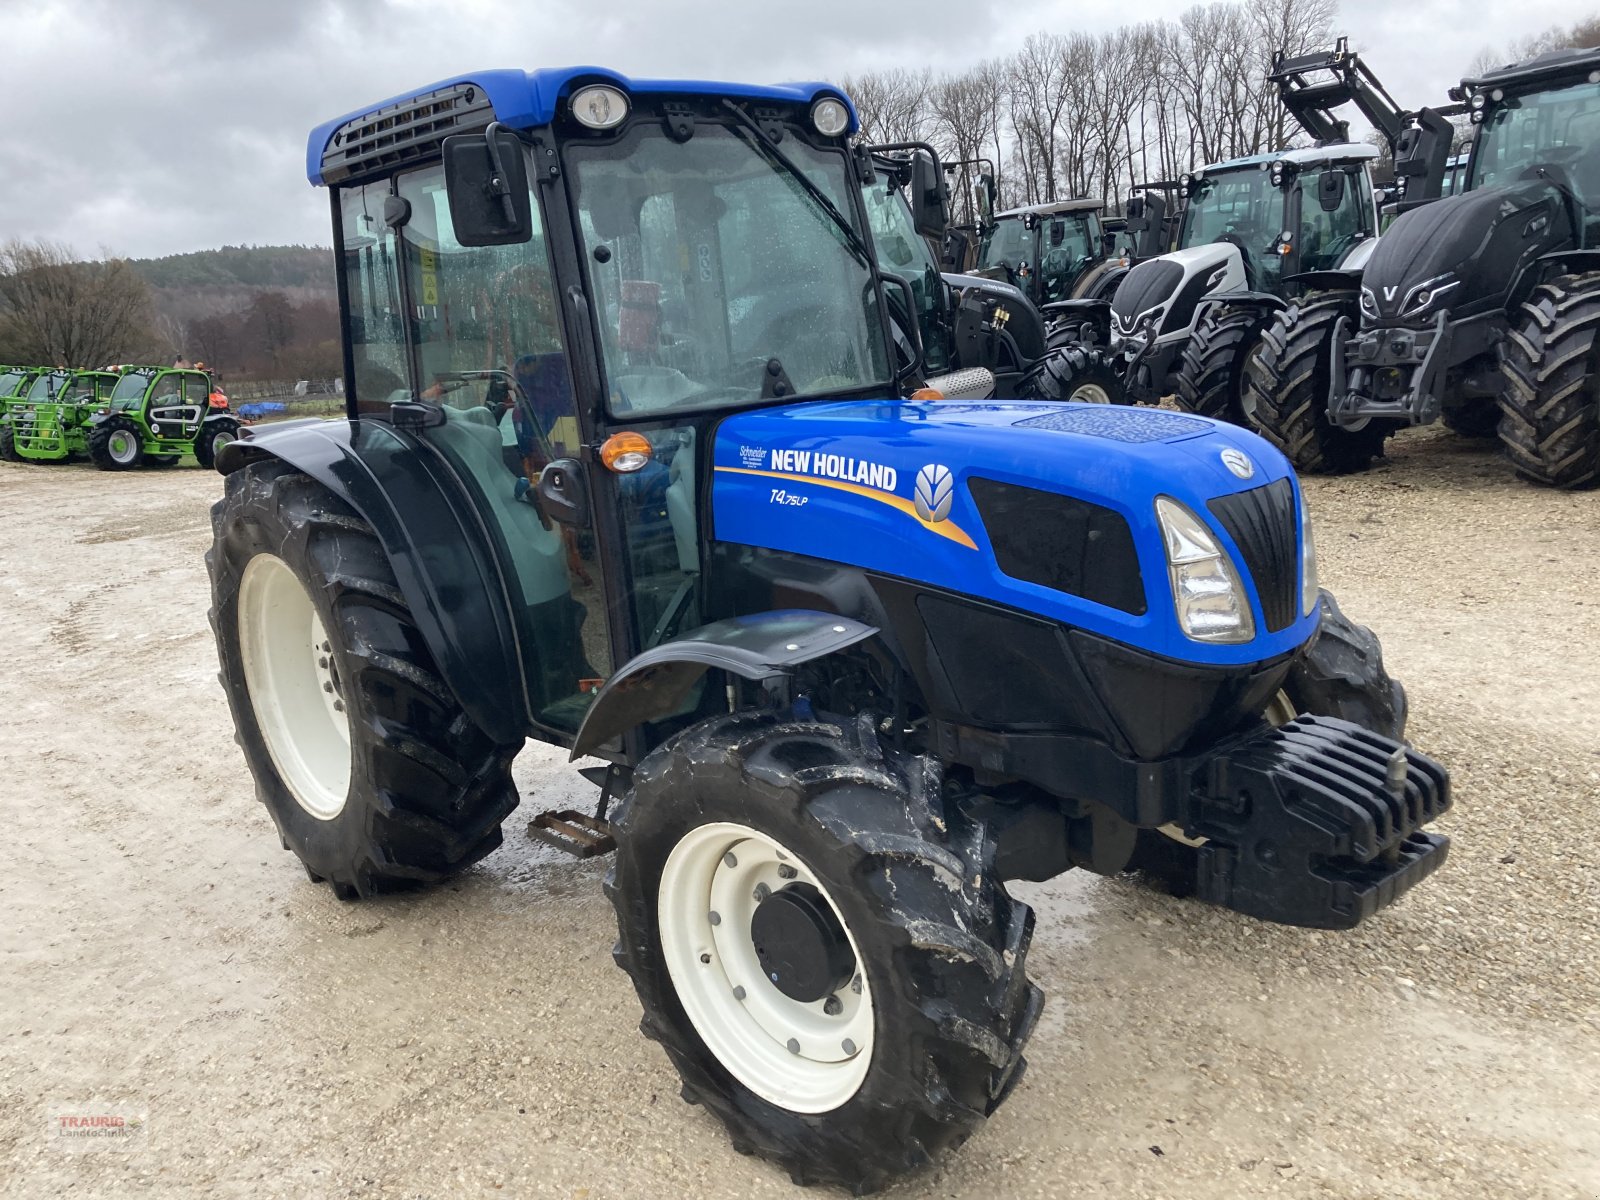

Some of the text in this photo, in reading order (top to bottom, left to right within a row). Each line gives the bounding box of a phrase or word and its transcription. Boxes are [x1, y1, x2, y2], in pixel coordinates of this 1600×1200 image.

[740, 445, 767, 458] Schneider
[771, 449, 897, 492] NEW HOLLAND
[770, 489, 808, 506] T4.75LP
